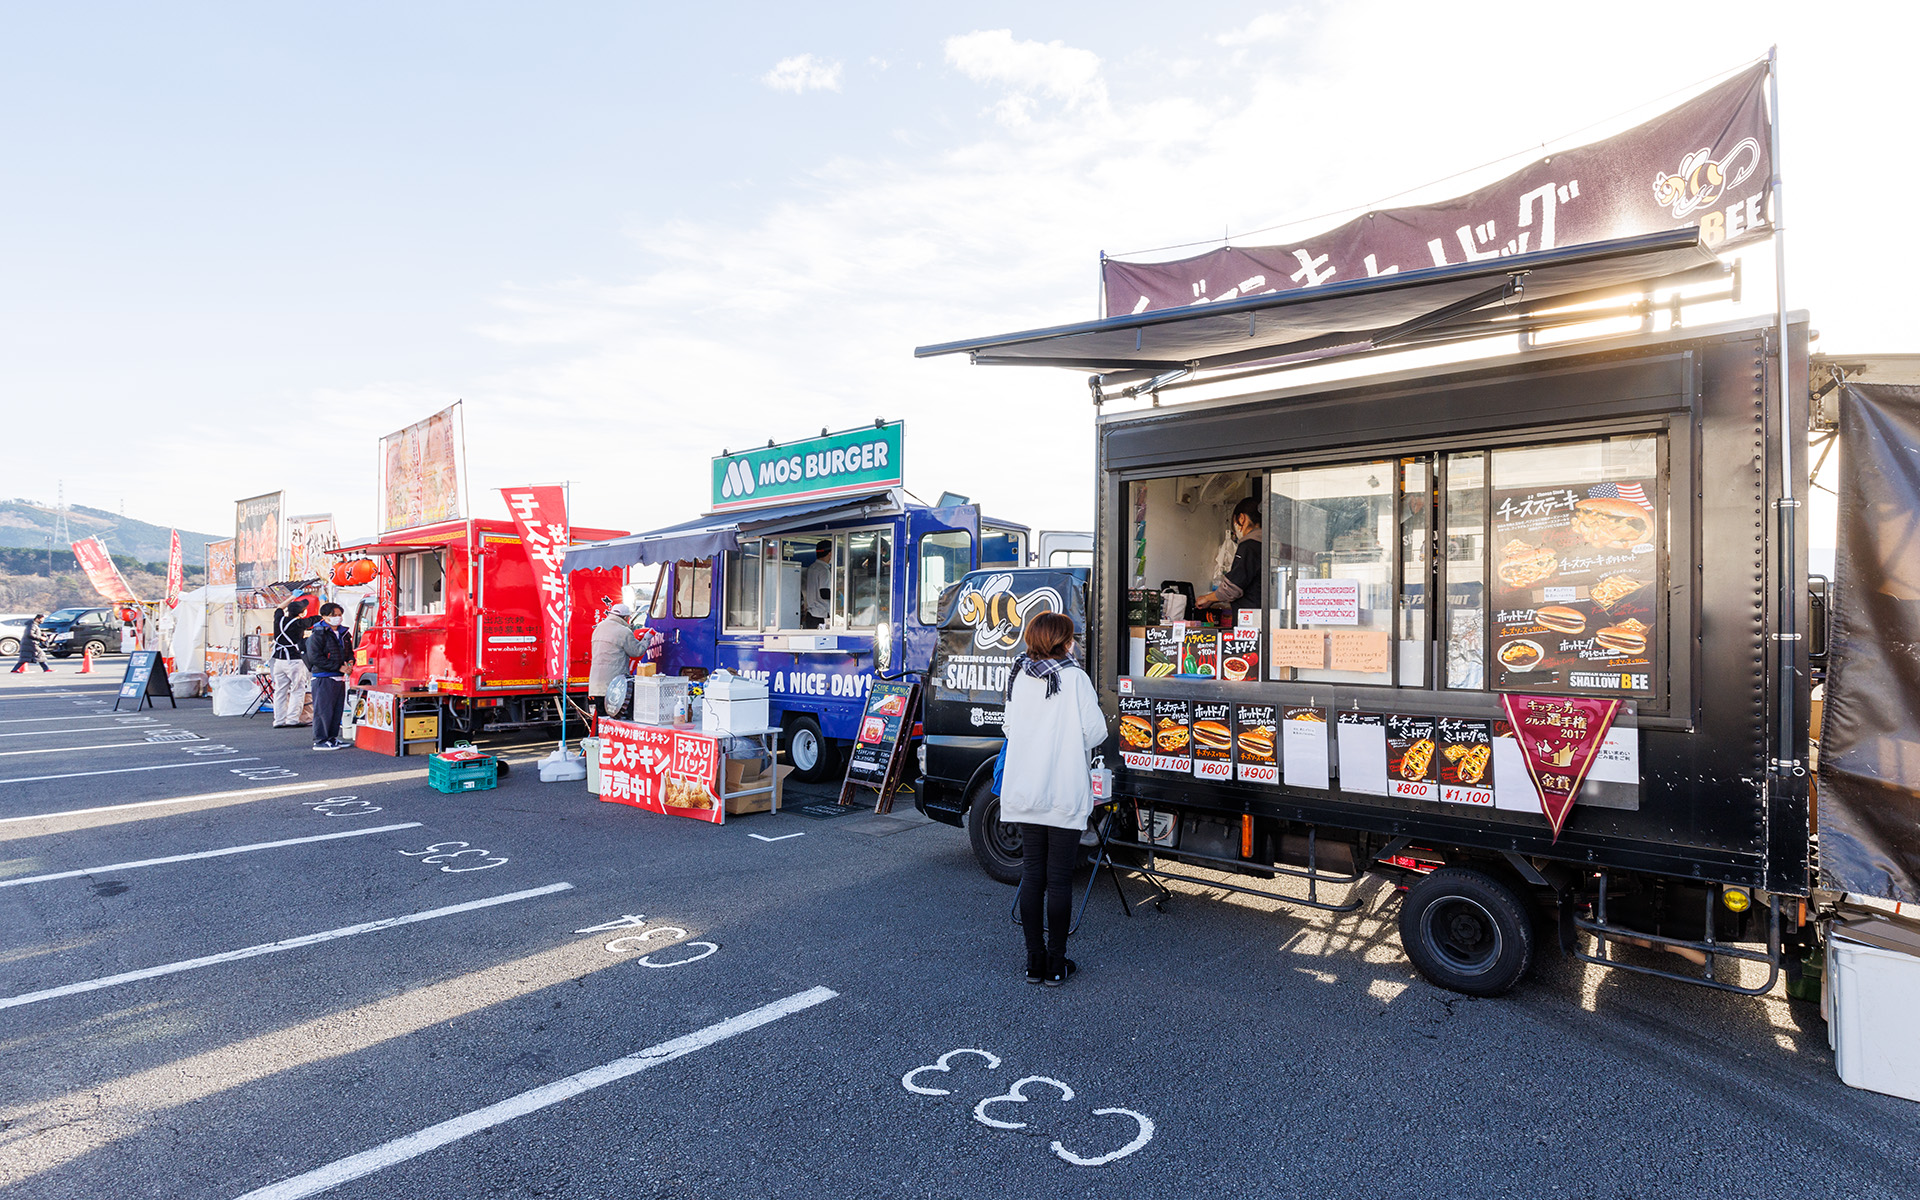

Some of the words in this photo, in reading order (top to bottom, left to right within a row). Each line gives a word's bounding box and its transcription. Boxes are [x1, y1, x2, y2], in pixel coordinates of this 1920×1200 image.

[758, 456, 802, 486] MOS
[805, 441, 888, 479] BURGER
[1496, 489, 1580, 522] チーズステーキ
[1559, 554, 1605, 571] チーズステーキ
[1497, 609, 1536, 623] ホットドッグ
[1236, 630, 1257, 639] ¥100
[1223, 640, 1257, 655] ミートソース
[1559, 637, 1595, 651] ホットドッグ
[948, 655, 986, 663] FISHING
[774, 671, 785, 693] A
[790, 672, 827, 695] NICE
[831, 673, 872, 698] DAY!
[1569, 675, 1621, 689] SHALLOW
[1621, 673, 1649, 690] BEE
[1119, 697, 1151, 710] チーズステーキ
[1155, 701, 1187, 713] チーズステーキ
[1195, 704, 1229, 718] ホットドッグ
[1527, 700, 1586, 715] キッチンカー
[1238, 706, 1274, 719] ホットドッグ
[1388, 714, 1412, 729] チーズ
[1438, 717, 1463, 732] チーズ
[1399, 726, 1434, 740] ミートドッグ
[1444, 729, 1479, 743] ミートドッグ
[1560, 729, 1587, 740] 2017
[677, 738, 711, 758] 5本入り
[599, 738, 671, 775] モスチキン
[1126, 754, 1151, 767] ¥800
[677, 755, 707, 774] パック
[1201, 763, 1230, 776] ¥600
[1244, 767, 1274, 780] ¥900
[1396, 783, 1428, 796] ¥800
[1541, 773, 1572, 791] 金賞
[399, 841, 509, 873] C35
[574, 913, 719, 969] C34
[902, 1048, 1155, 1166] C33
